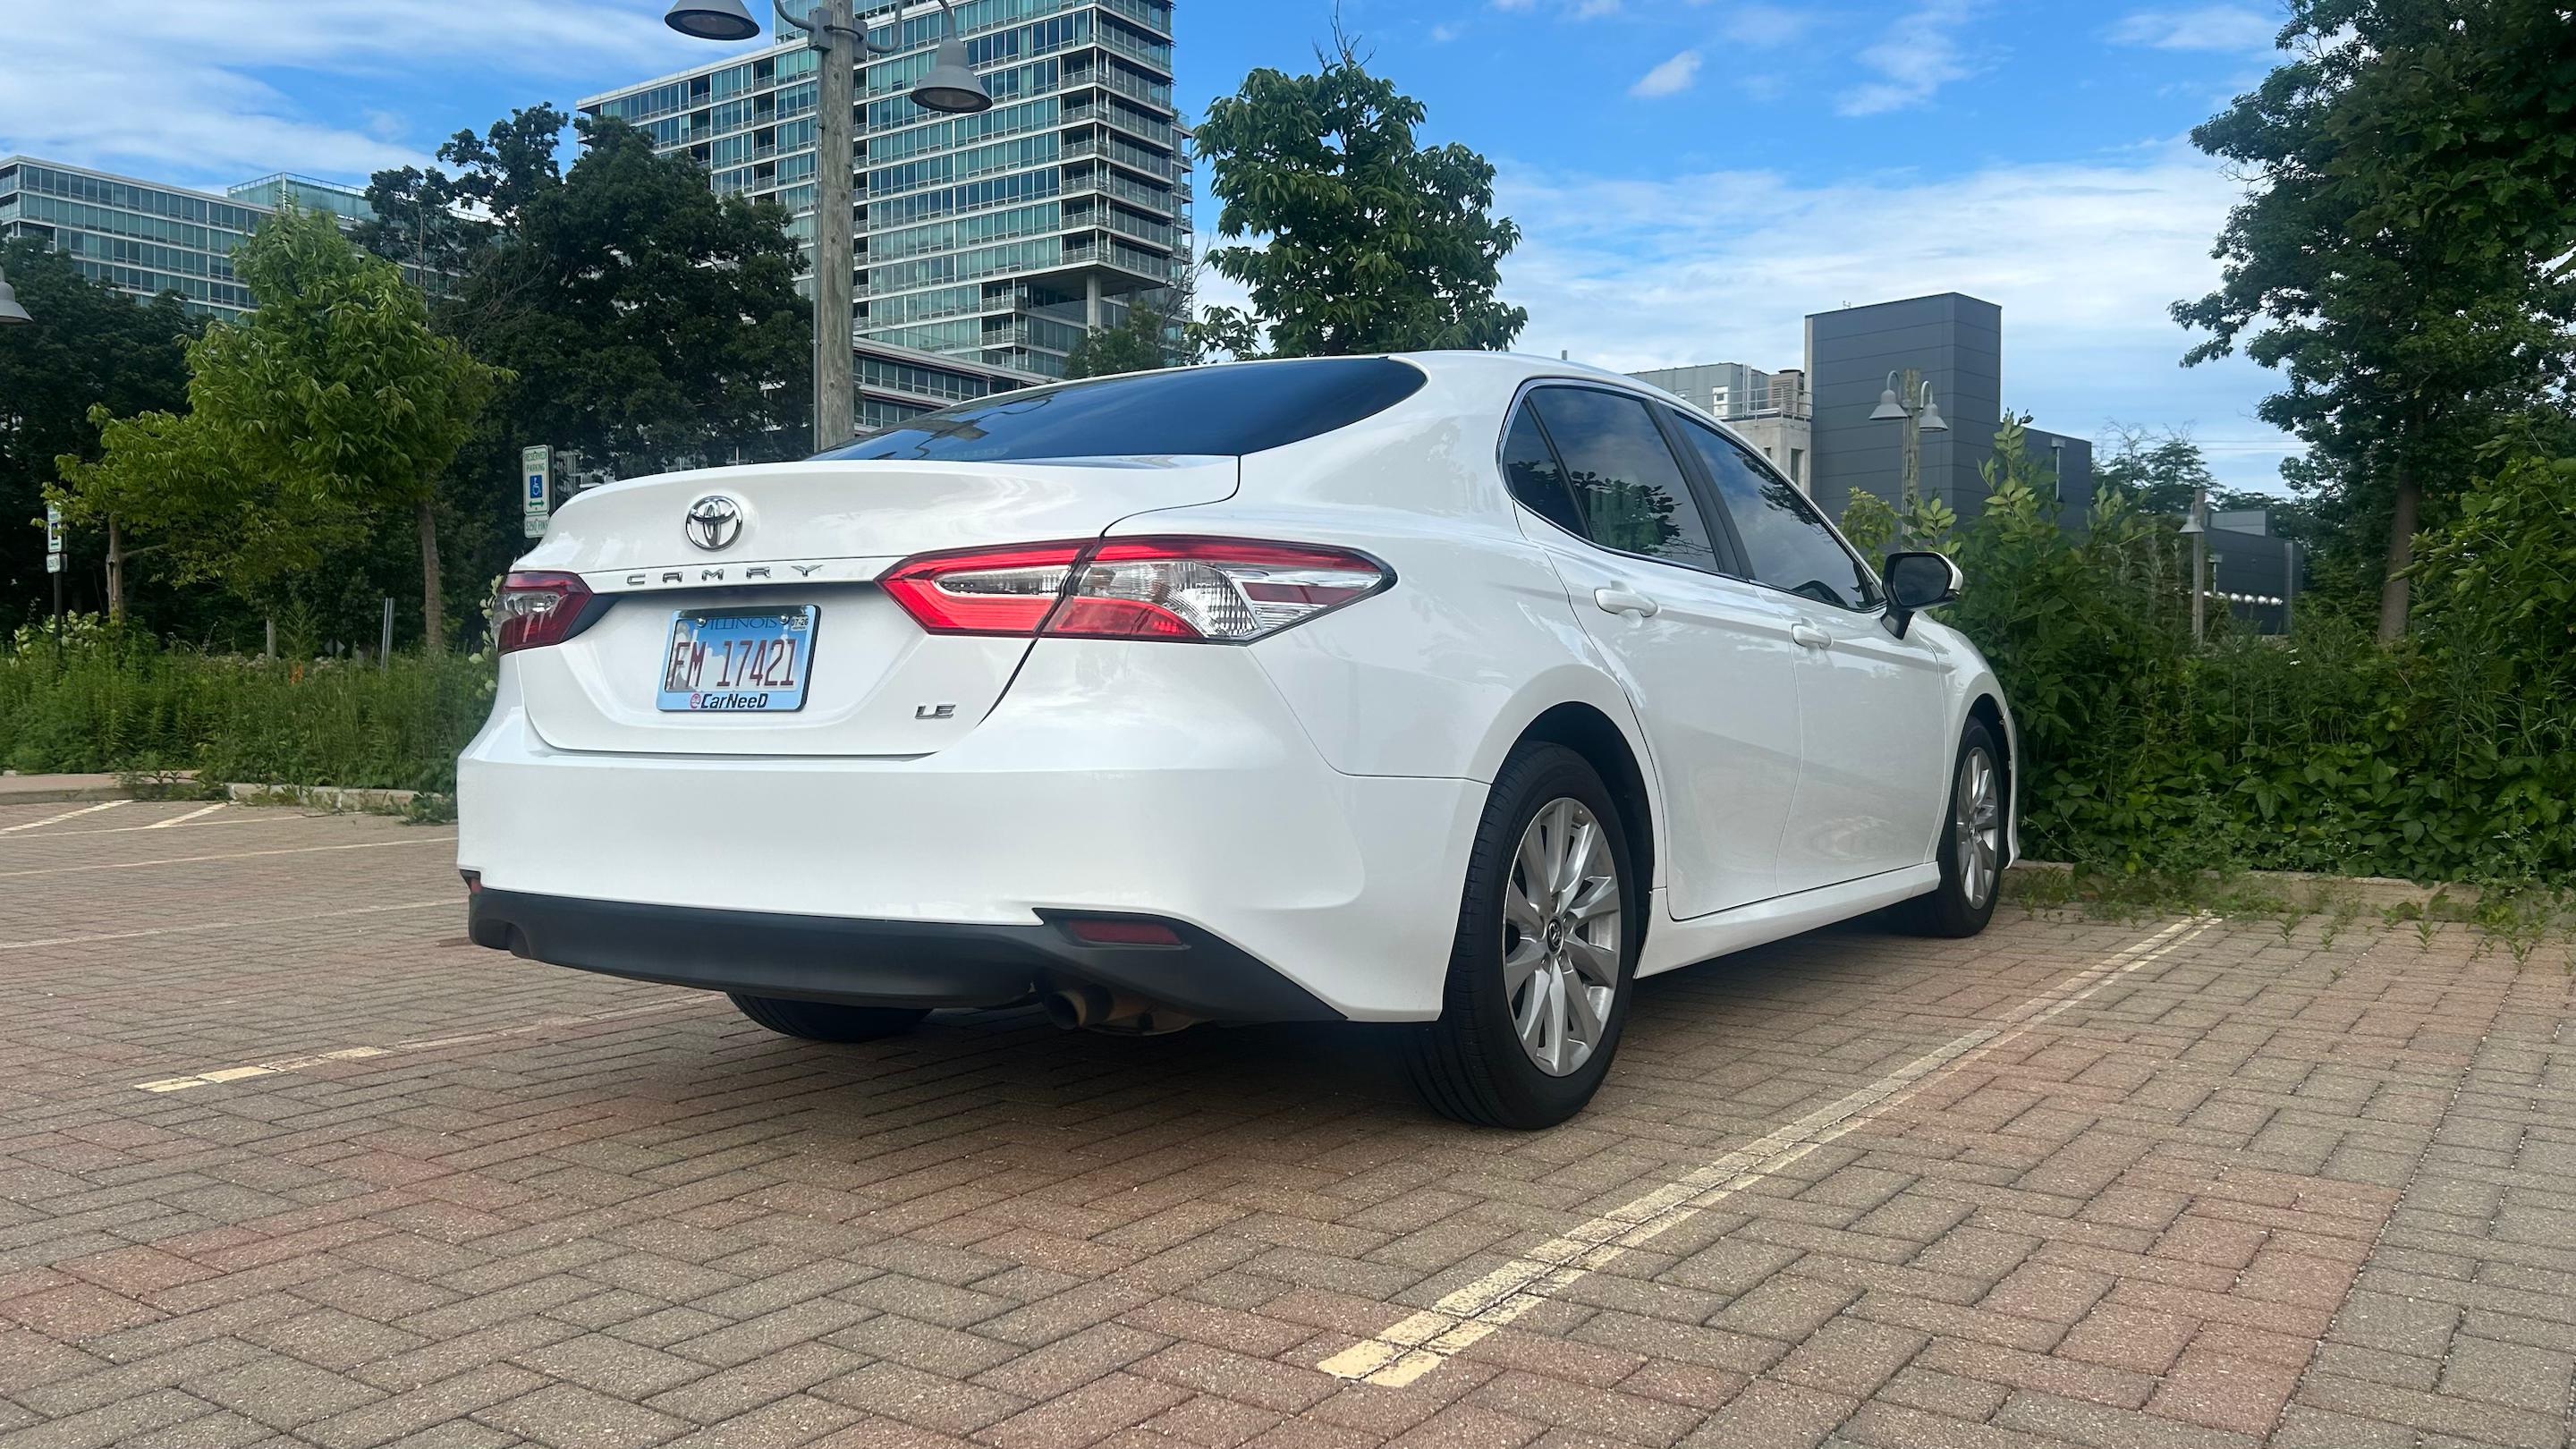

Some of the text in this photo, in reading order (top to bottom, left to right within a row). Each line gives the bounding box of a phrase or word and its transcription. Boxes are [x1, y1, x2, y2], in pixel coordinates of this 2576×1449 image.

[525, 451, 547, 462] RESERVED
[527, 462, 546, 473] PARKING
[538, 520, 549, 530] FIN
[626, 564, 824, 586] CAMRY
[708, 616, 778, 630] ILLINOIS
[671, 638, 797, 688] FM 17421
[915, 704, 956, 719] LE
